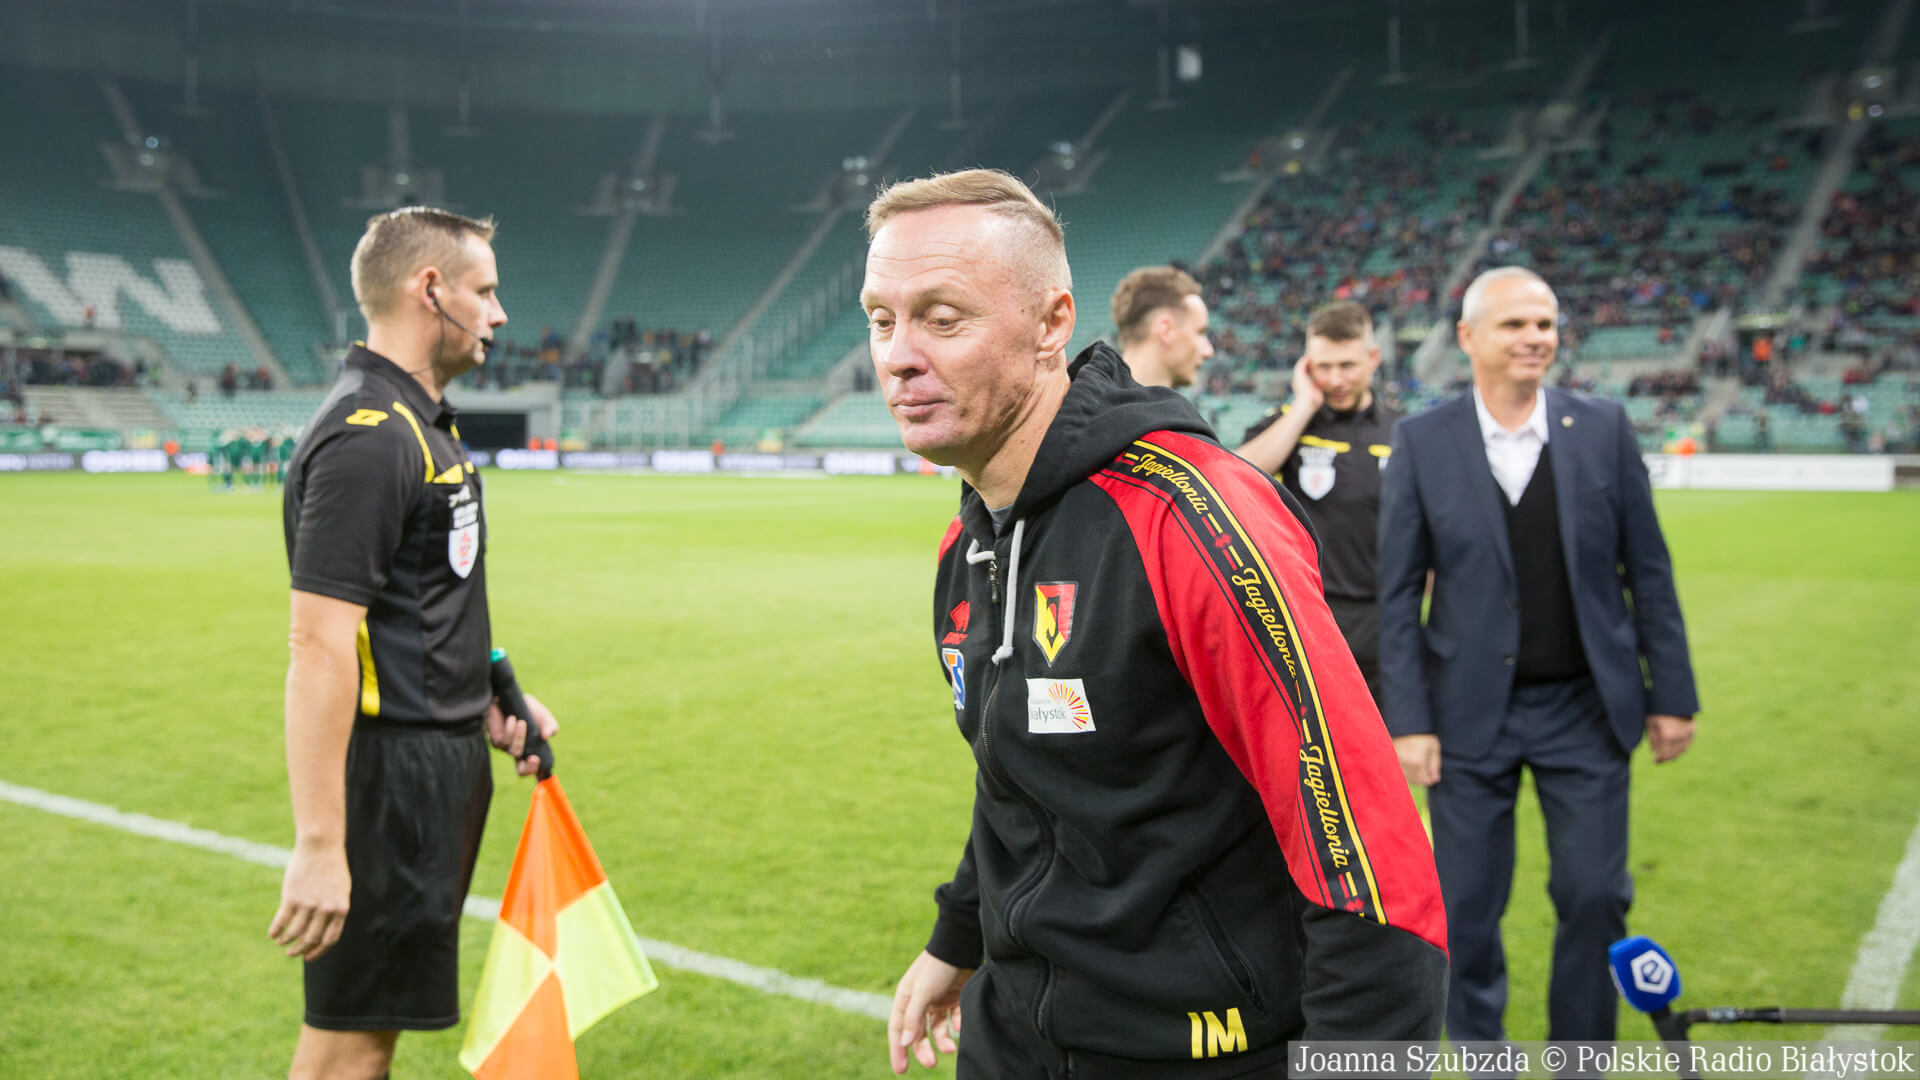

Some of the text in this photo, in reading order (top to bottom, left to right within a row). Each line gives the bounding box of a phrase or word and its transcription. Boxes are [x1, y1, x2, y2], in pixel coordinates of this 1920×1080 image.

[1132, 453, 1209, 514] Jagiellonia
[1232, 567, 1297, 680] Jagiellonia
[1300, 745, 1349, 869] Jagiellonia
[1187, 1008, 1248, 1058] IM
